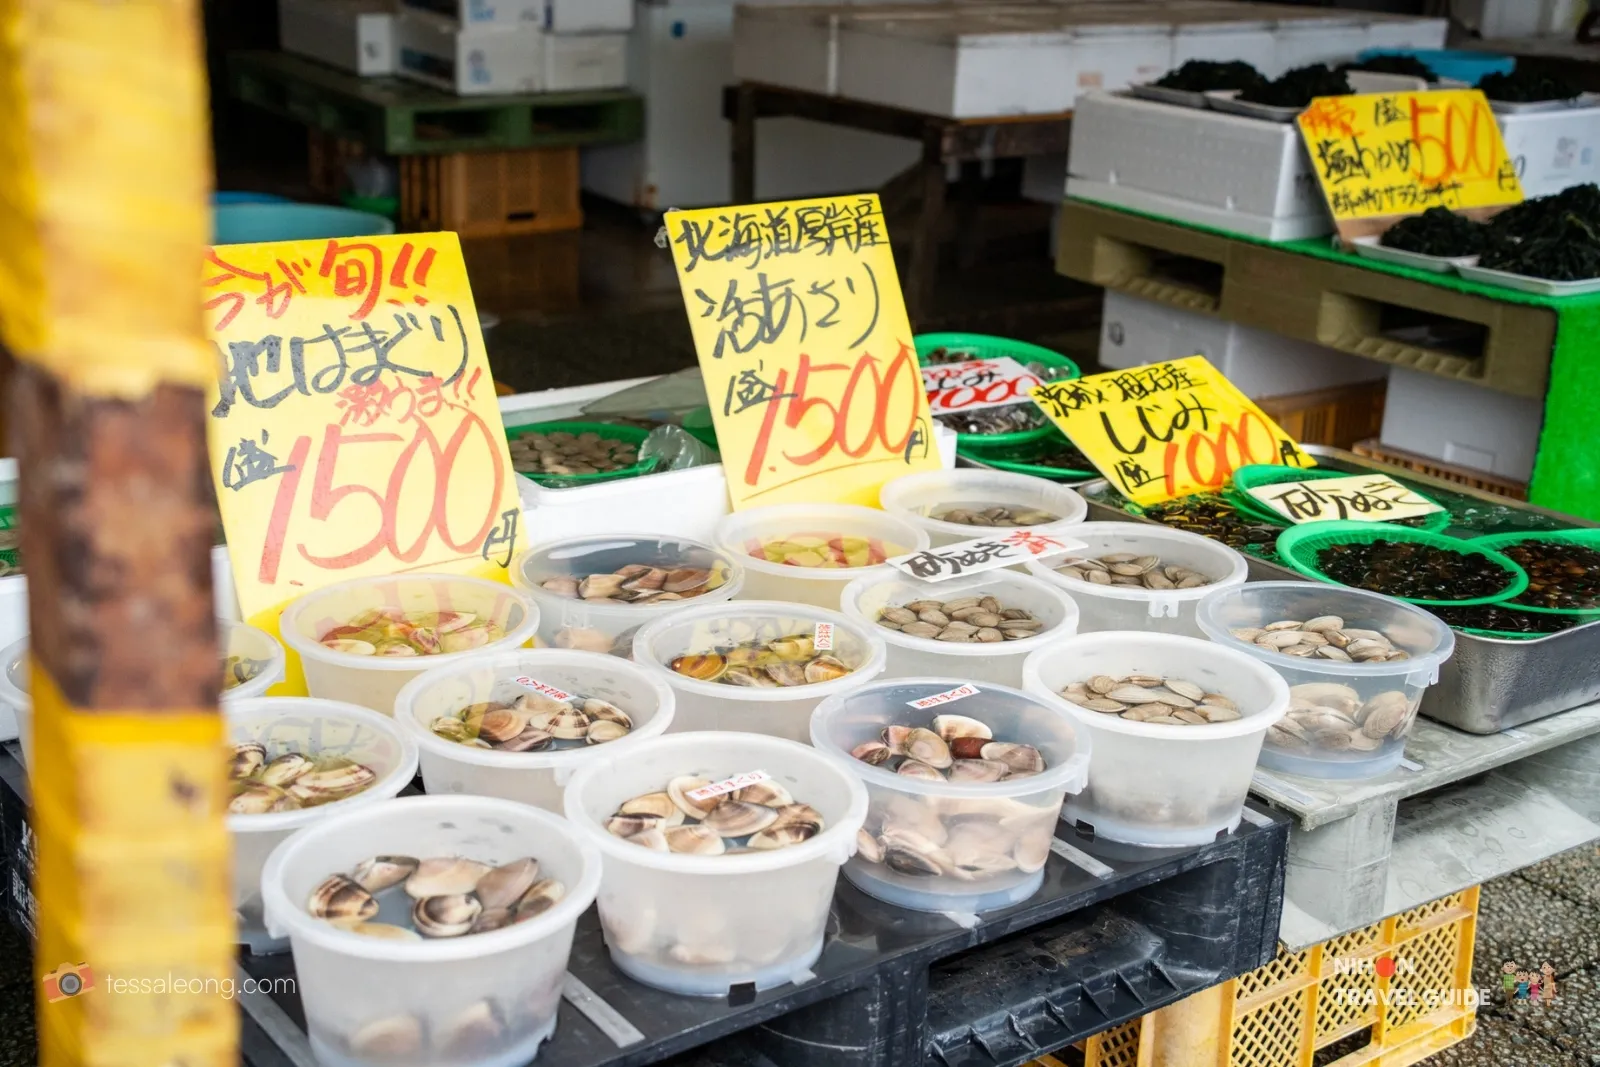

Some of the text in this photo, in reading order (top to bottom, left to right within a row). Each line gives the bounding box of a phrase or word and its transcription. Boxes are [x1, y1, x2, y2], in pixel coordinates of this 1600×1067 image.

[675, 198, 889, 273] 北海道厚岸産
[694, 262, 880, 359] 活あさり
[1099, 393, 1218, 455] しじみ
